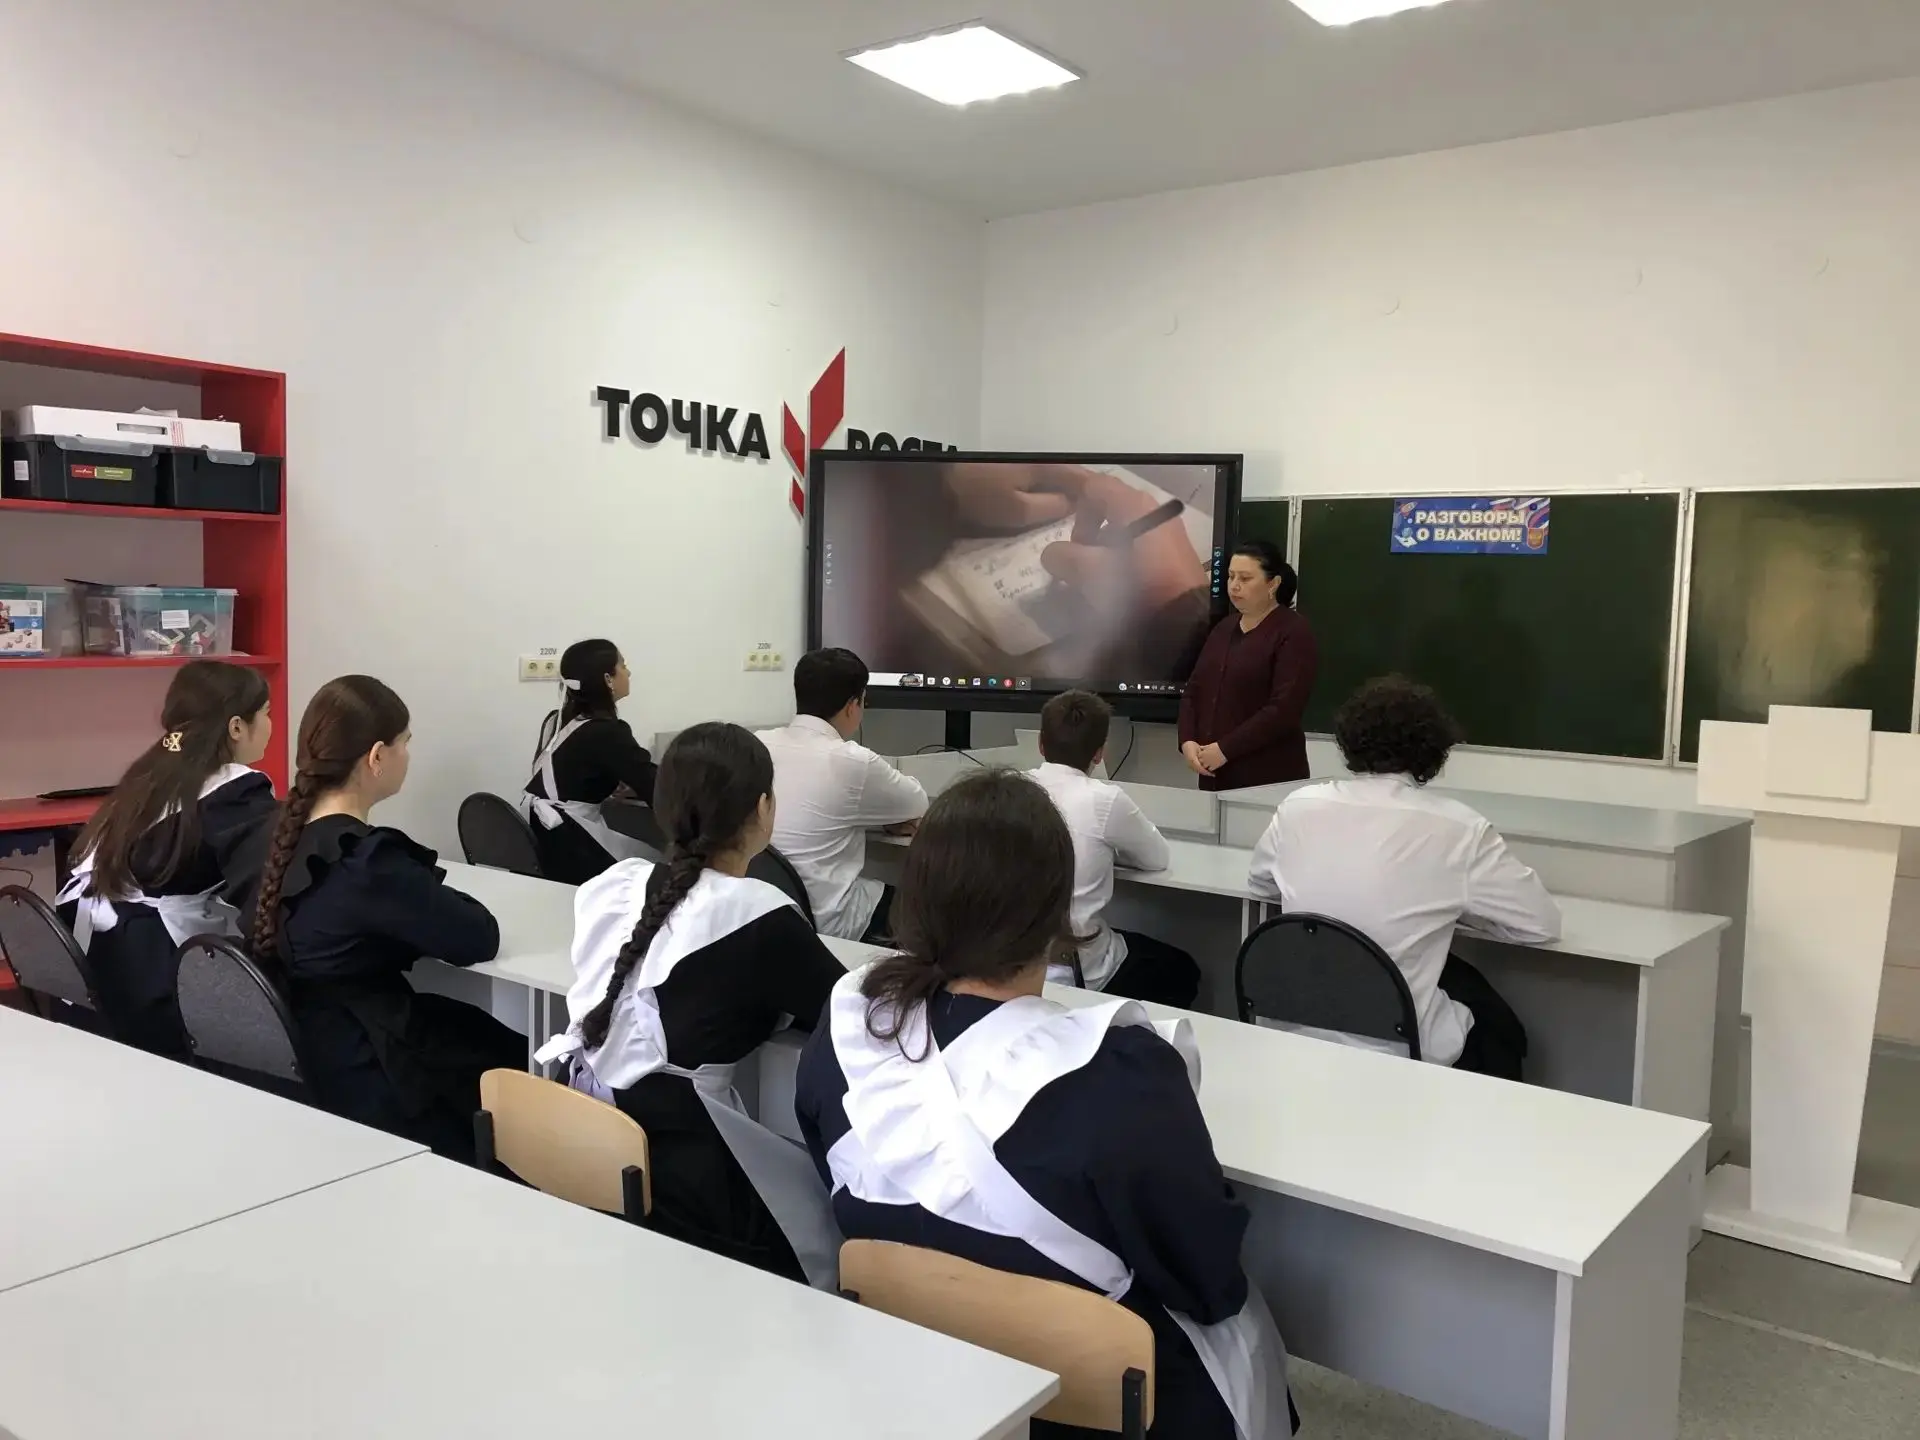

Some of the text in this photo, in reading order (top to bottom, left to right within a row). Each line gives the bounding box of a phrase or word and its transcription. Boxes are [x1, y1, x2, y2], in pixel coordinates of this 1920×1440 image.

[597, 385, 770, 459] ТОЧКА
[1415, 510, 1525, 524] РАЗГОВОРЫ
[1416, 528, 1522, 542] О ВАЖНОМ!
